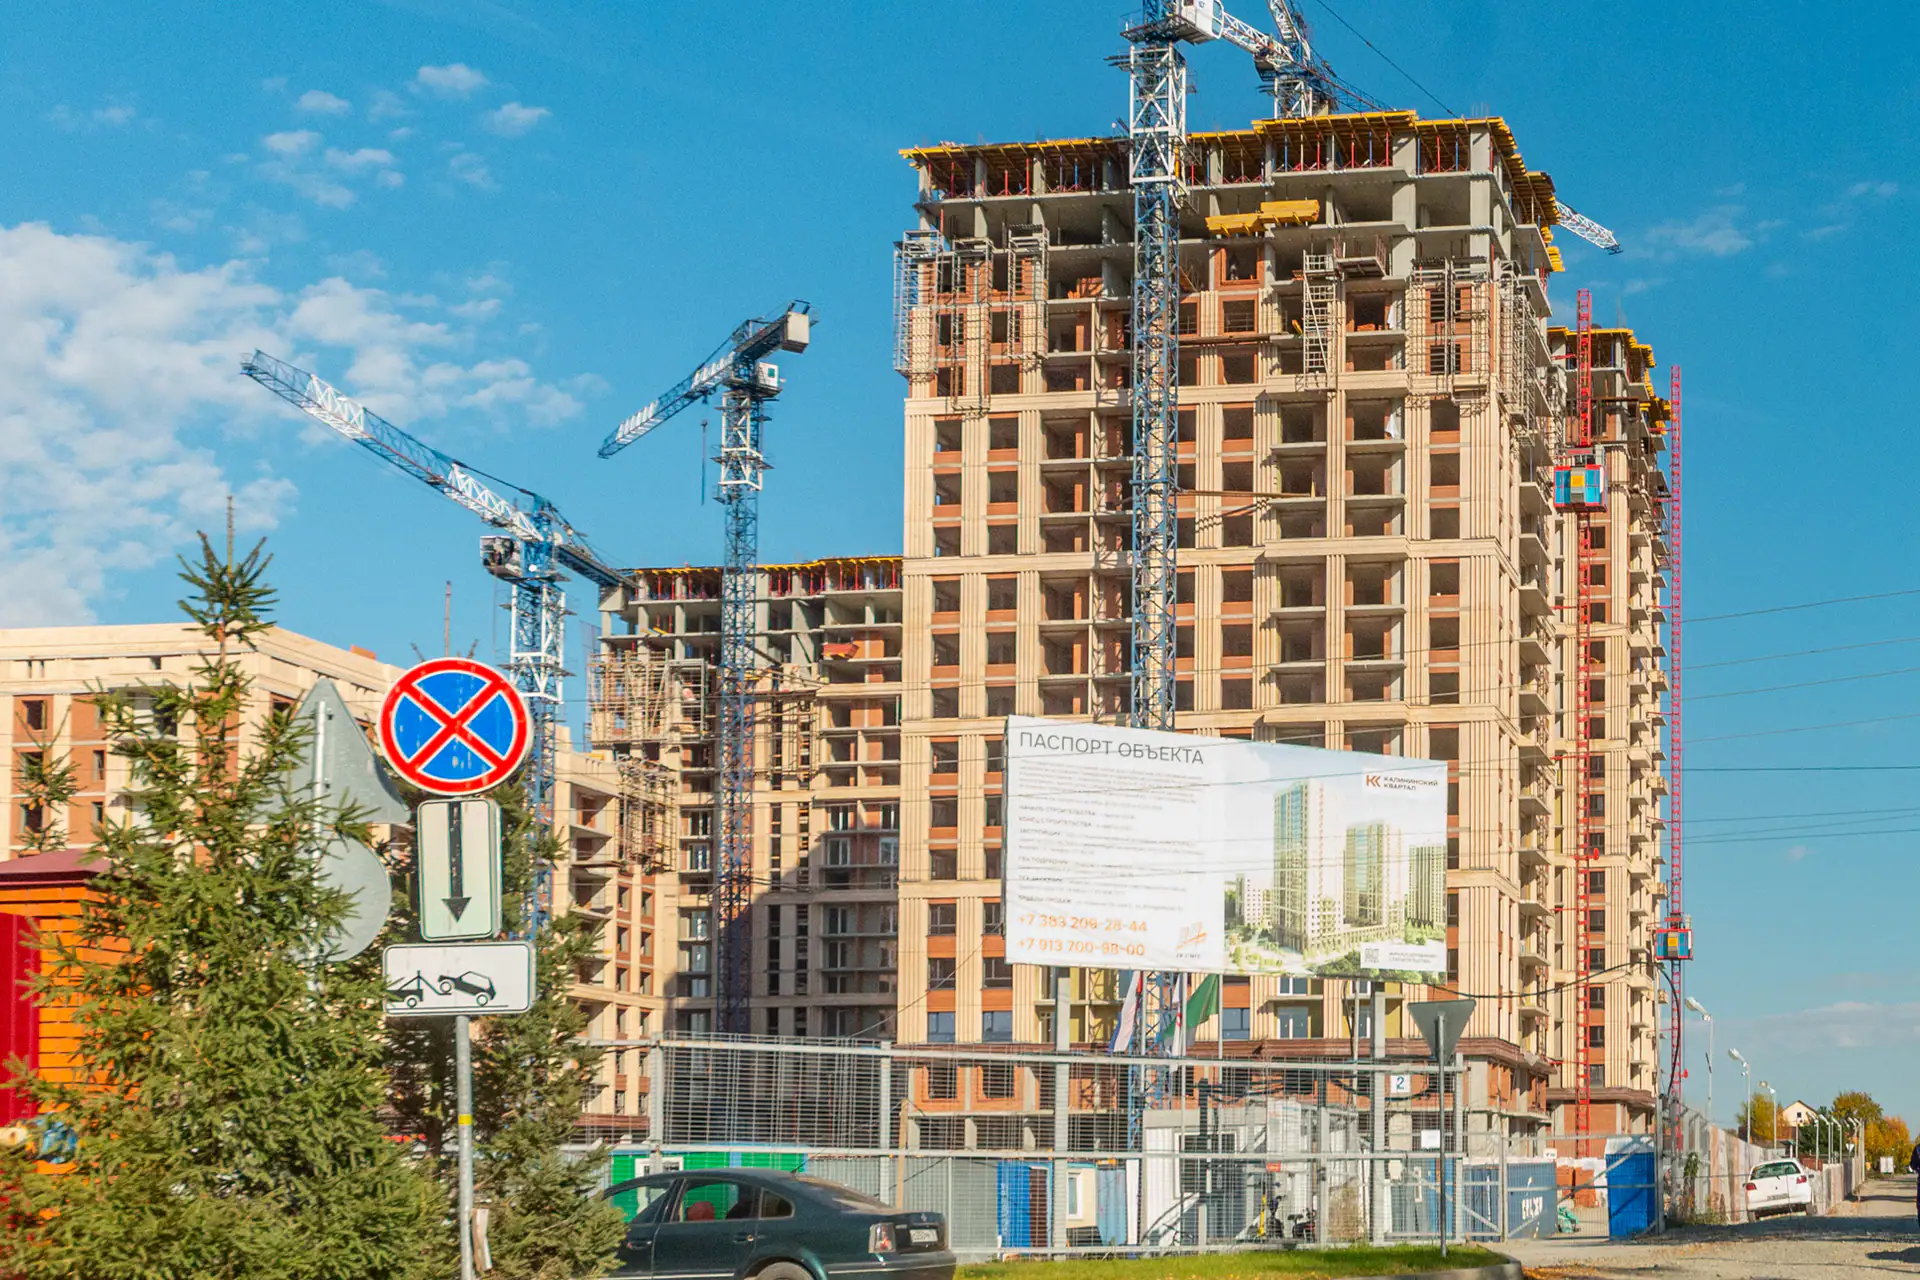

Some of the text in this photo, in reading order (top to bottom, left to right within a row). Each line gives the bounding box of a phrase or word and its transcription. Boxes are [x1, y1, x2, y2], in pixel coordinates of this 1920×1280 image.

[1020, 732, 1204, 765] ПАСПОРТ ОБЪЕКТА
[1383, 776, 1438, 786] КАЛИНИНСКИЙ
[1383, 783, 1416, 791] КВАРТАЛ
[1019, 913, 1035, 926] +7
[1019, 938, 1035, 951] +7
[1039, 938, 1063, 952] 913
[1396, 1076, 1405, 1090] 2
